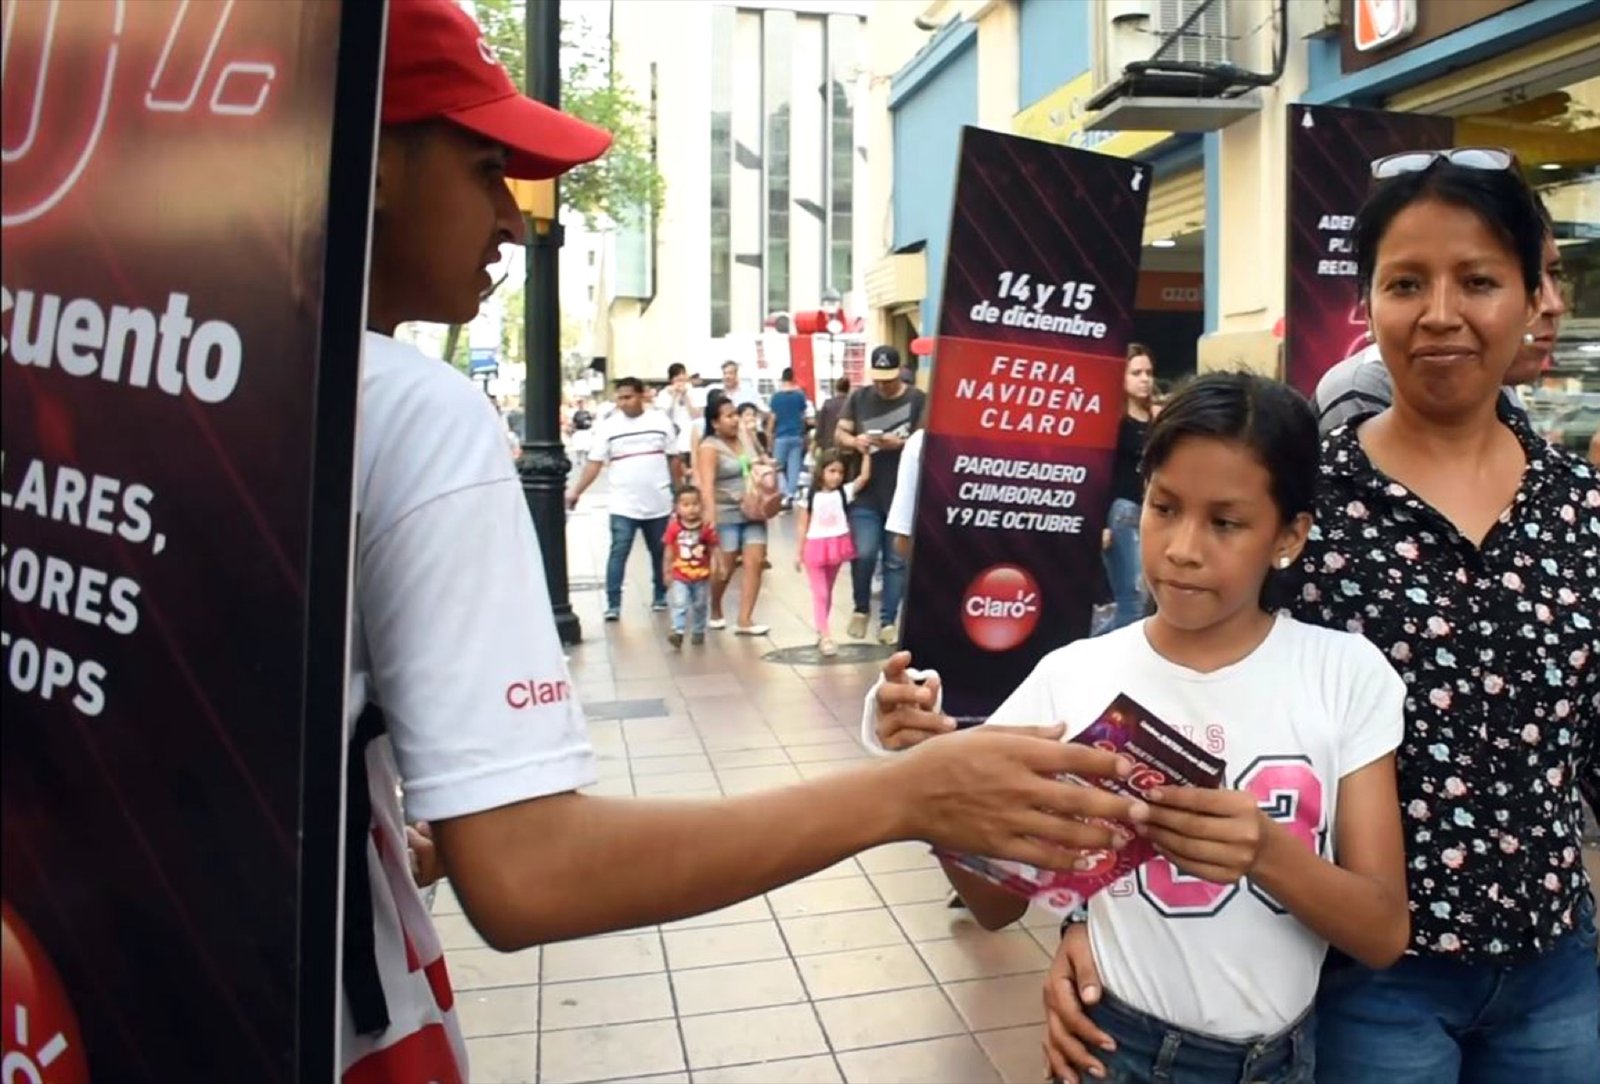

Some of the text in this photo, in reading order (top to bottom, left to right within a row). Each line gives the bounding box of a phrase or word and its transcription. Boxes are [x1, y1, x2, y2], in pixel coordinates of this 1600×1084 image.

[999, 271, 1095, 311] 14 y 15
[970, 300, 1107, 338] de diciembre
[991, 356, 1076, 385] FERIA
[956, 378, 1101, 414] NAVIDEÑA
[980, 407, 1075, 436] CLARO
[954, 455, 1086, 484] PARQUEADERO
[959, 482, 1076, 508] CHIMBORAZO
[947, 507, 1083, 534] Y 9 DE OCTUBRE
[1, 542, 142, 636] ORES
[967, 595, 1026, 618] Claro
[506, 680, 569, 710] Clar
